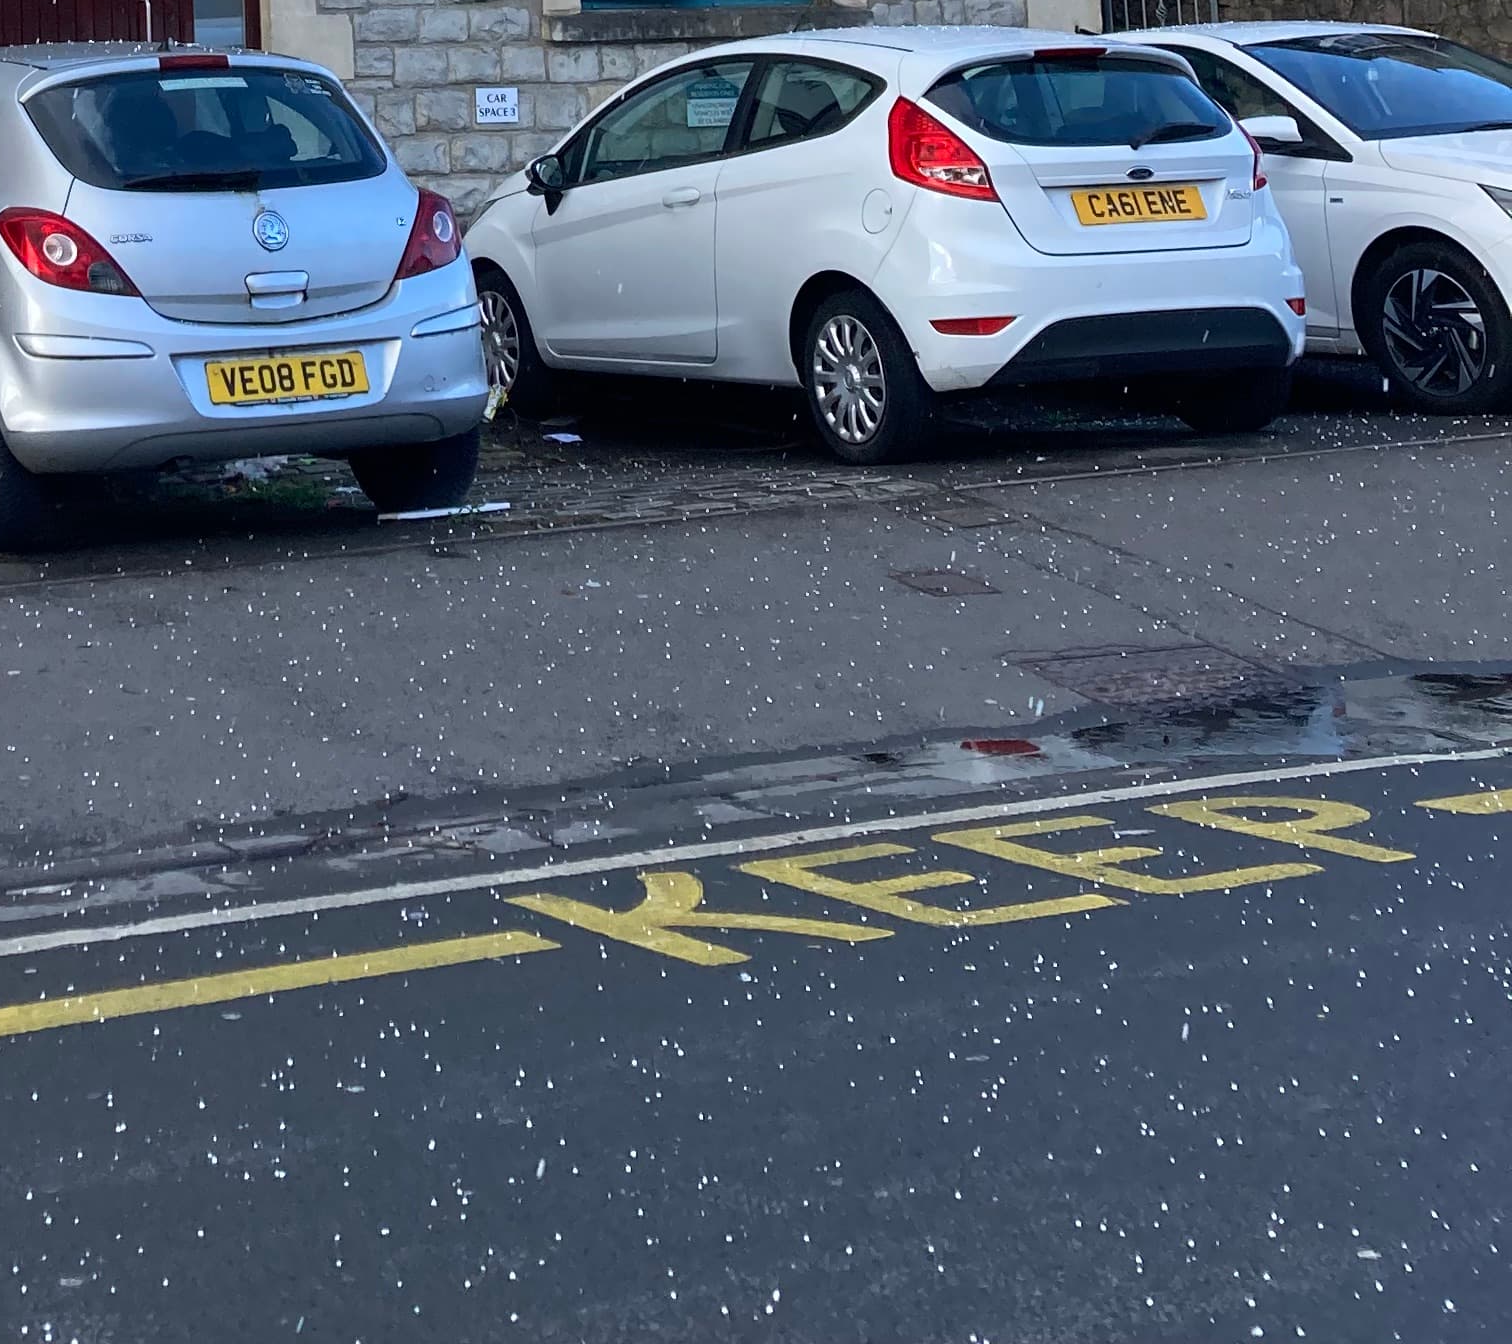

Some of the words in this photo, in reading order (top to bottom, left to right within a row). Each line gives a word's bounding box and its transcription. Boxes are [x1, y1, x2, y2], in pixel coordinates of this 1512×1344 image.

[487, 93, 507, 103] CAR
[479, 107, 508, 117] SPACE
[510, 107, 516, 117] 3
[1088, 191, 1143, 218] CA61
[110, 232, 154, 244] CORSA
[220, 362, 295, 397] VE08
[300, 358, 356, 391] FGD
[505, 796, 1418, 967] KEEP
